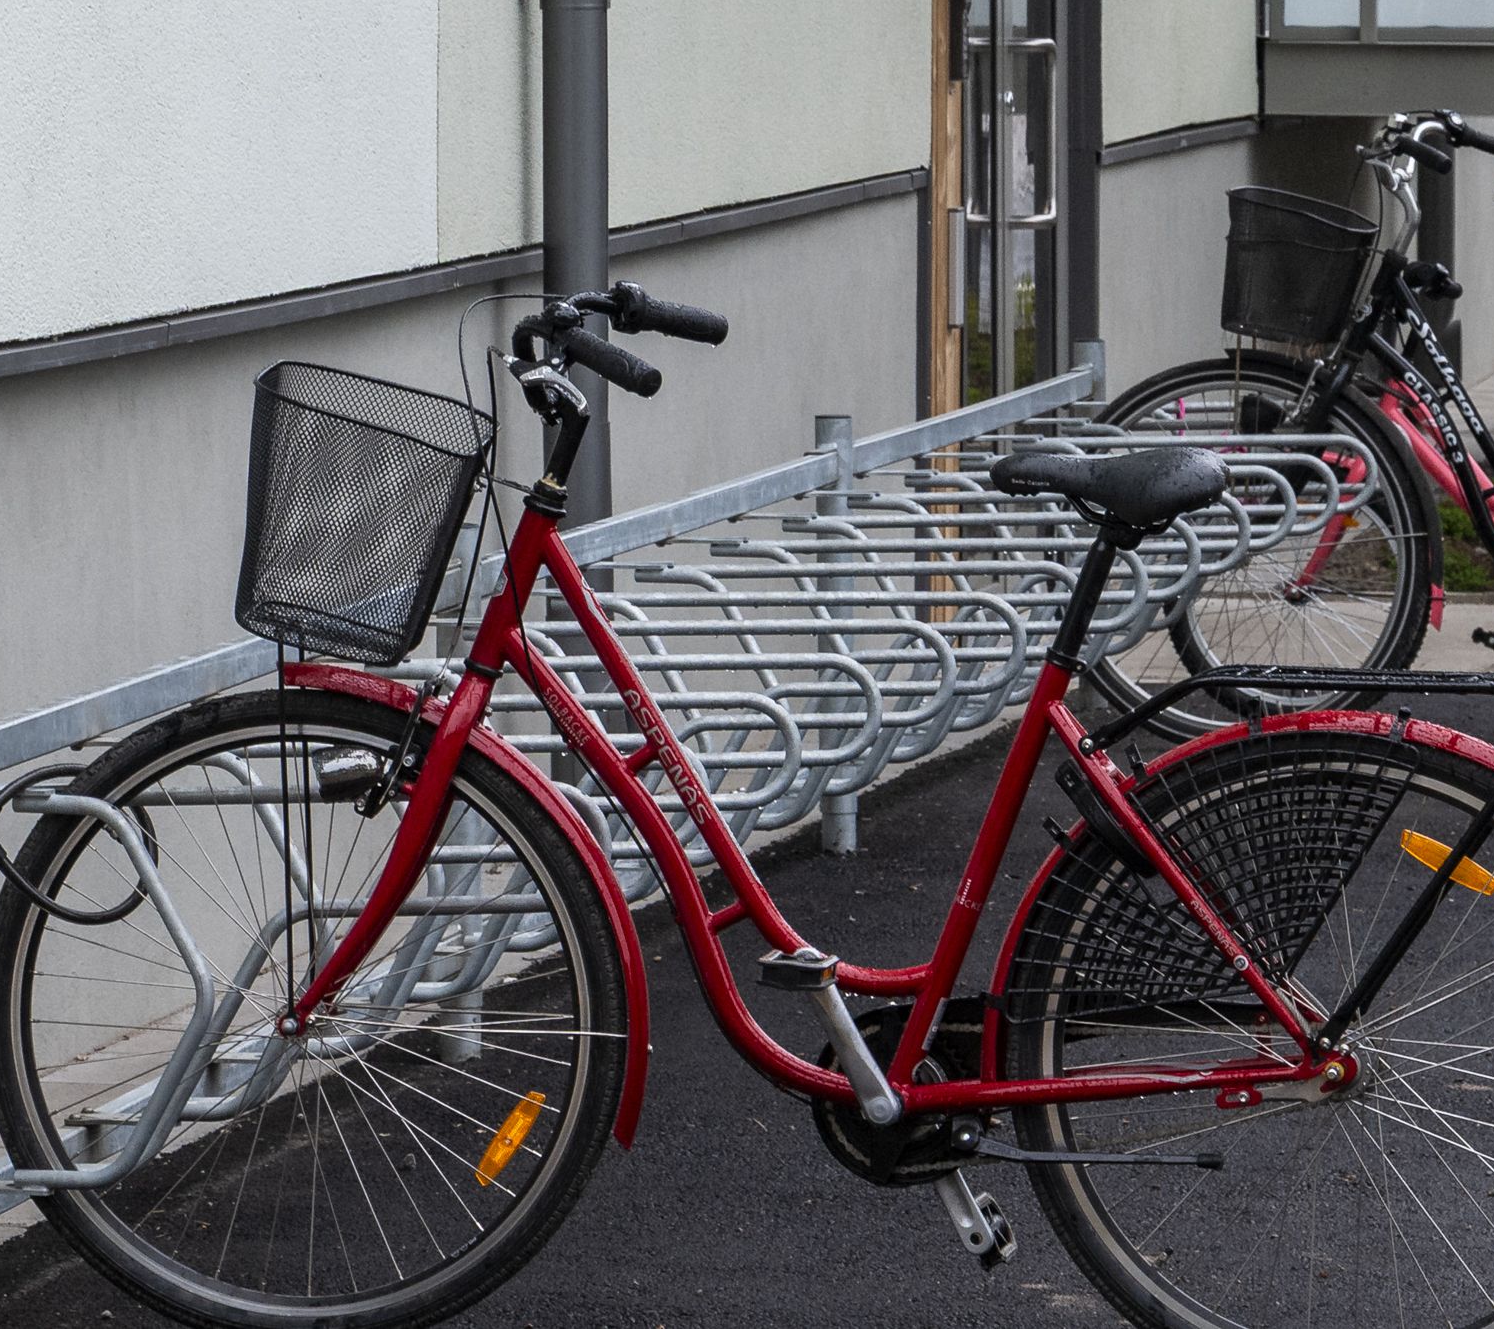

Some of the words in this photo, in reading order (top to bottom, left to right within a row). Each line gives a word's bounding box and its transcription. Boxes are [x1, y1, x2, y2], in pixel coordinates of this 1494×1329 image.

[1403, 371, 1458, 447] CLASSIC
[1451, 450, 1464, 464] 3
[1406, 308, 1485, 435] Solhaga
[624, 688, 712, 826] ASPENÄS
